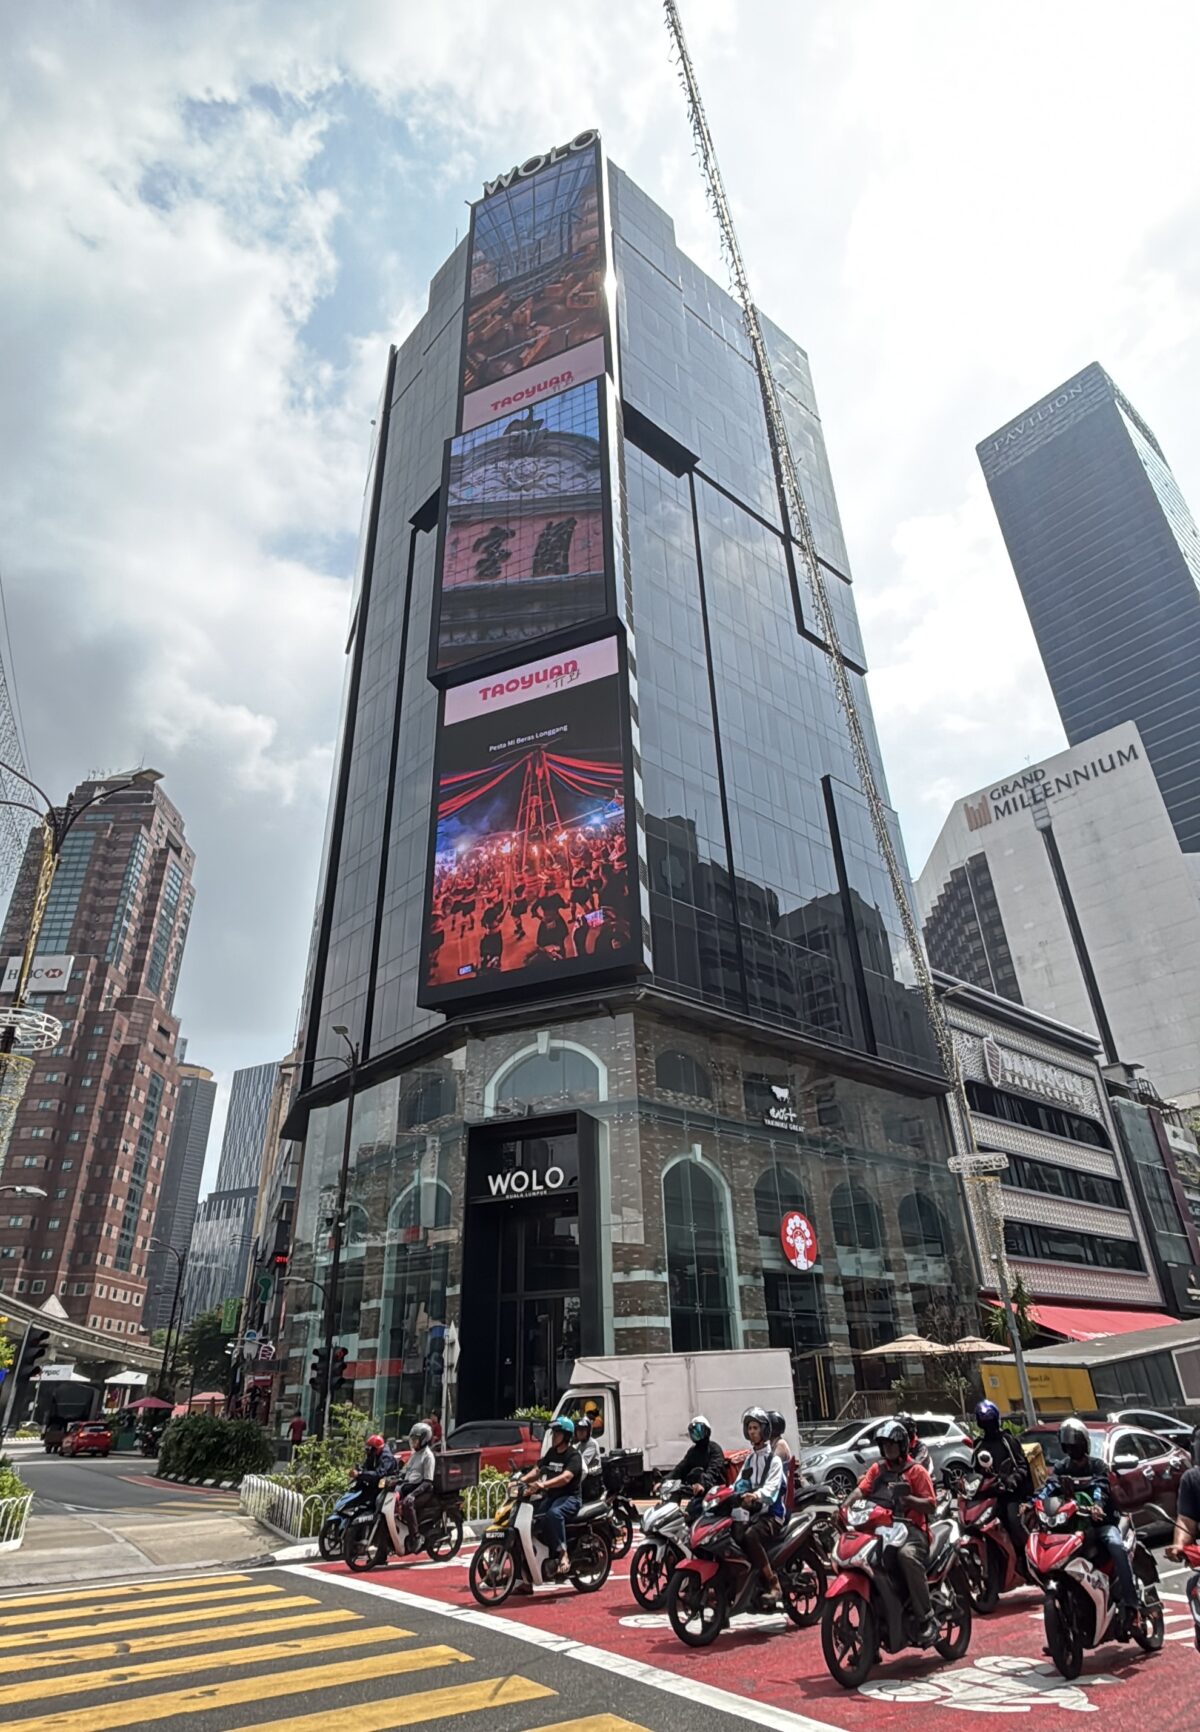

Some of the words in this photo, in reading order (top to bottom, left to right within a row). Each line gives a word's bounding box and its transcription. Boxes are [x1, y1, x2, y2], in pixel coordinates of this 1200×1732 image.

[483, 129, 599, 195] WOLO
[993, 383, 1084, 451] PAVILION
[489, 742, 507, 753] Pesta
[516, 734, 535, 744] Beras
[535, 724, 568, 739] Longgang
[990, 768, 1046, 801] GRAND
[993, 744, 1139, 821] MILLENNIUM
[764, 1118, 788, 1128] YAKINIKU
[789, 1123, 806, 1132] GREAT
[488, 1166, 564, 1196] WOLO
[525, 1190, 548, 1198] LUMPUR
